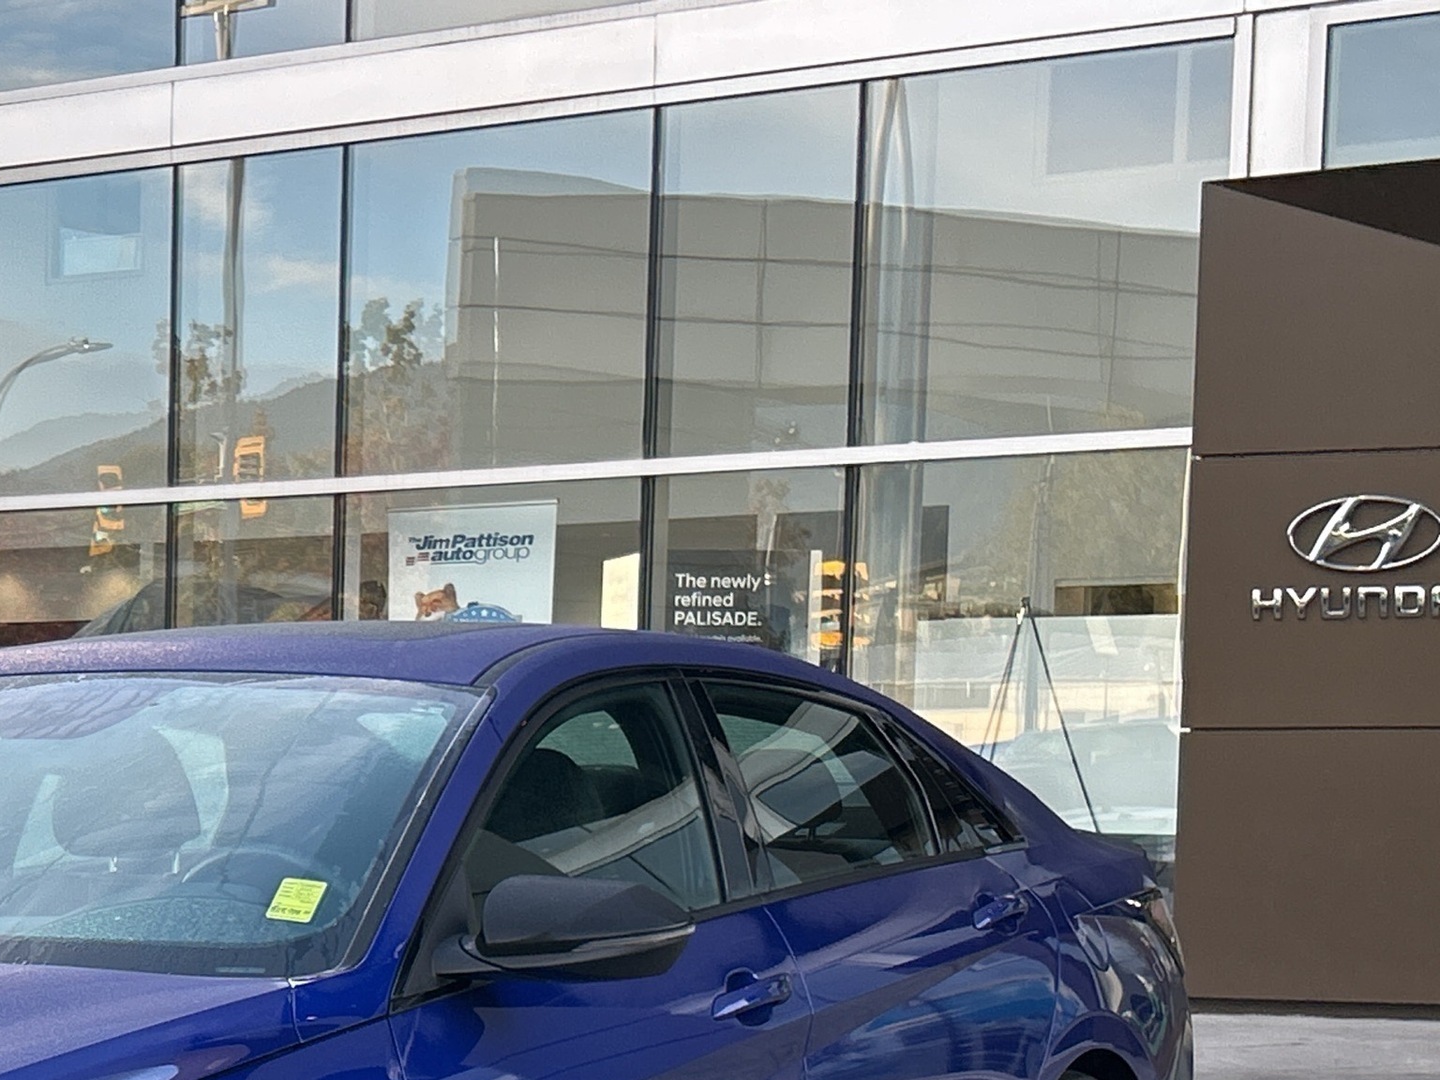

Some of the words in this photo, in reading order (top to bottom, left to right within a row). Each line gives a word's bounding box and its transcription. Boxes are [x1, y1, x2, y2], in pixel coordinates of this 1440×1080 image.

[675, 573, 707, 588] The
[710, 573, 761, 592] newly
[674, 591, 734, 607] refined
[674, 610, 763, 626] PALISADE.
